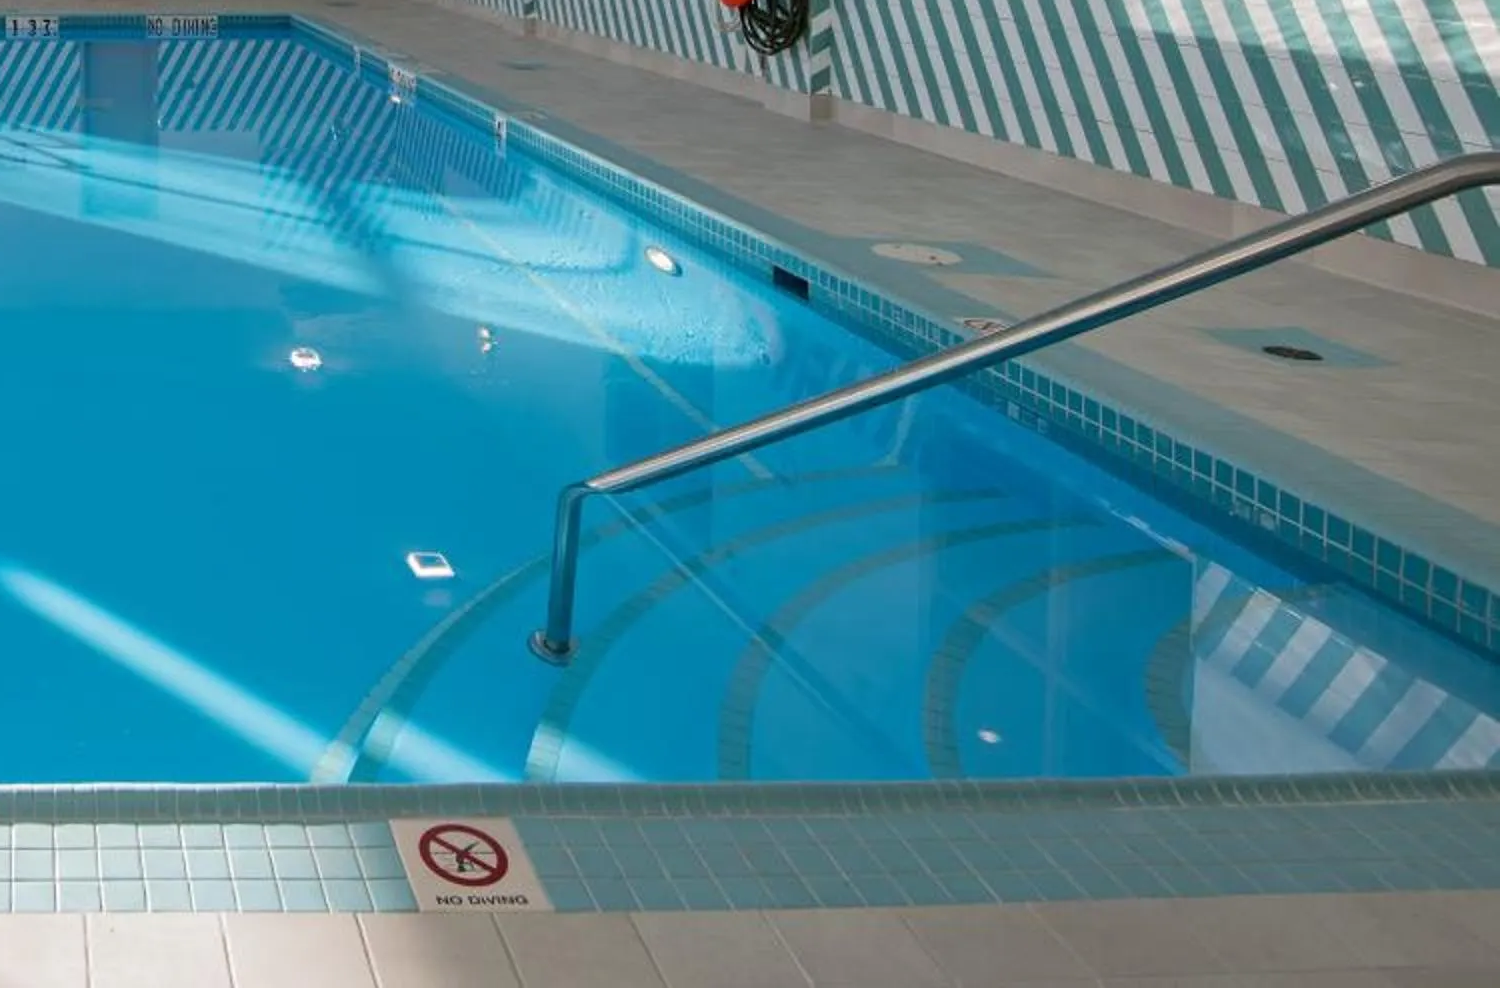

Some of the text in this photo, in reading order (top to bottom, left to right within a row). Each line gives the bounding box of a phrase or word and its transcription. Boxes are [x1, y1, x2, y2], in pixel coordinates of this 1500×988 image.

[147, 18, 217, 37] NO DIVING
[436, 894, 528, 905] NO DIVING
